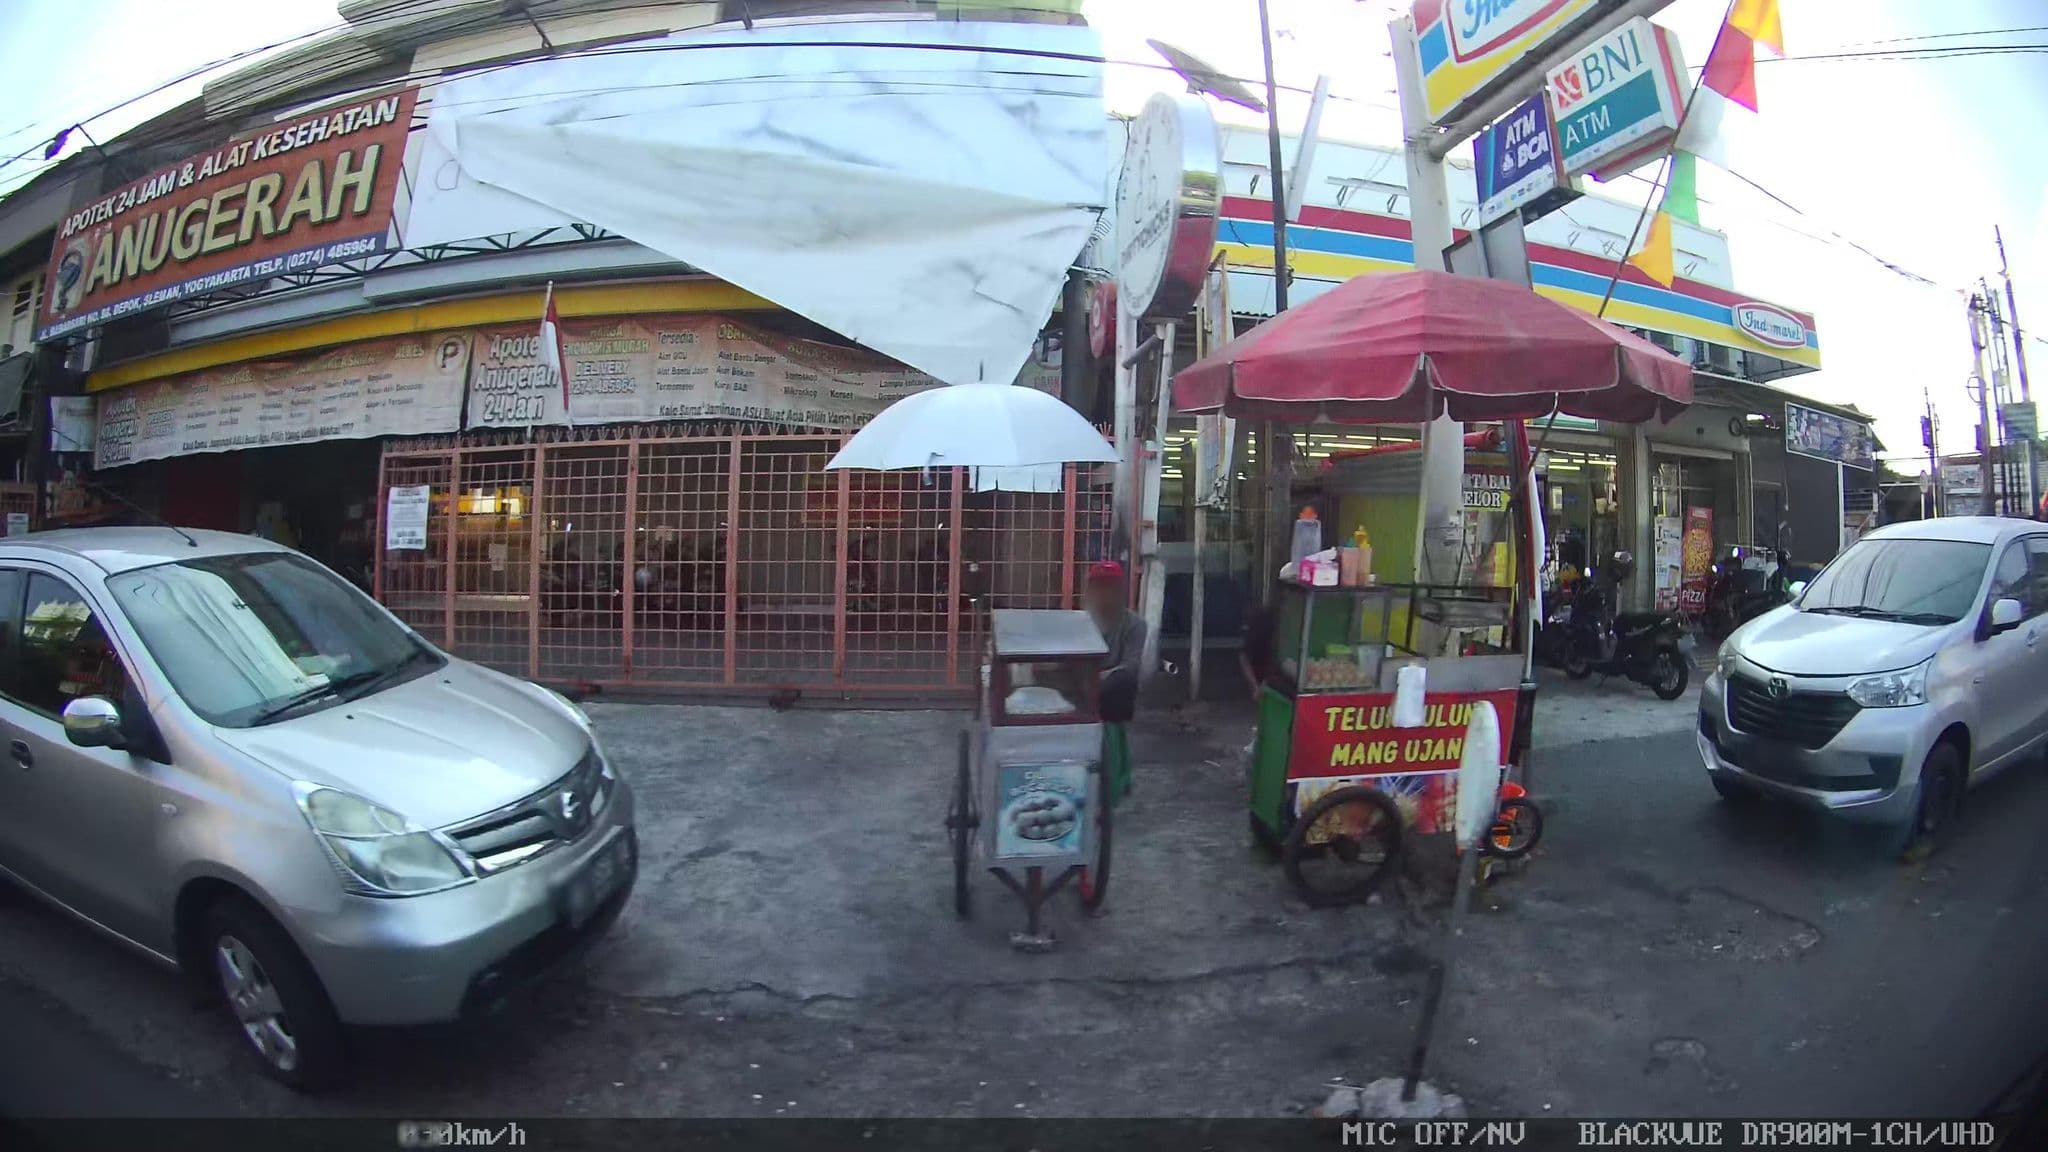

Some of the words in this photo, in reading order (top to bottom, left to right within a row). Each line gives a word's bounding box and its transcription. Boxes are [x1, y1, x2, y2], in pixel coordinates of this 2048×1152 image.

[1582, 29, 1643, 93] BNI
[1505, 110, 1536, 149] ATM
[1566, 105, 1611, 149] ATM
[60, 196, 117, 239] APOTEK
[116, 187, 137, 213] 24
[136, 170, 176, 204] JAM
[179, 163, 195, 186] &
[198, 141, 253, 180] ALAT
[253, 97, 400, 160] KESEHATAN
[1517, 131, 1549, 168] BCA
[86, 144, 383, 294] ANUGERAH
[113, 299, 142, 316] DEPOK,
[144, 284, 182, 307] SLEMAN,
[184, 265, 254, 294] YOGYAKARTA
[254, 258, 284, 277] TELP.
[287, 249, 325, 272] (0274)
[328, 238, 377, 260] 485964
[490, 334, 540, 363] Apote
[576, 360, 632, 376] DELIVERY
[1463, 491, 1501, 507] ELOR
[1682, 590, 1705, 602] PIZZA
[1424, 703, 1477, 727] ULUN
[1330, 741, 1398, 766] MANG
[1404, 738, 1463, 762] UJAN
